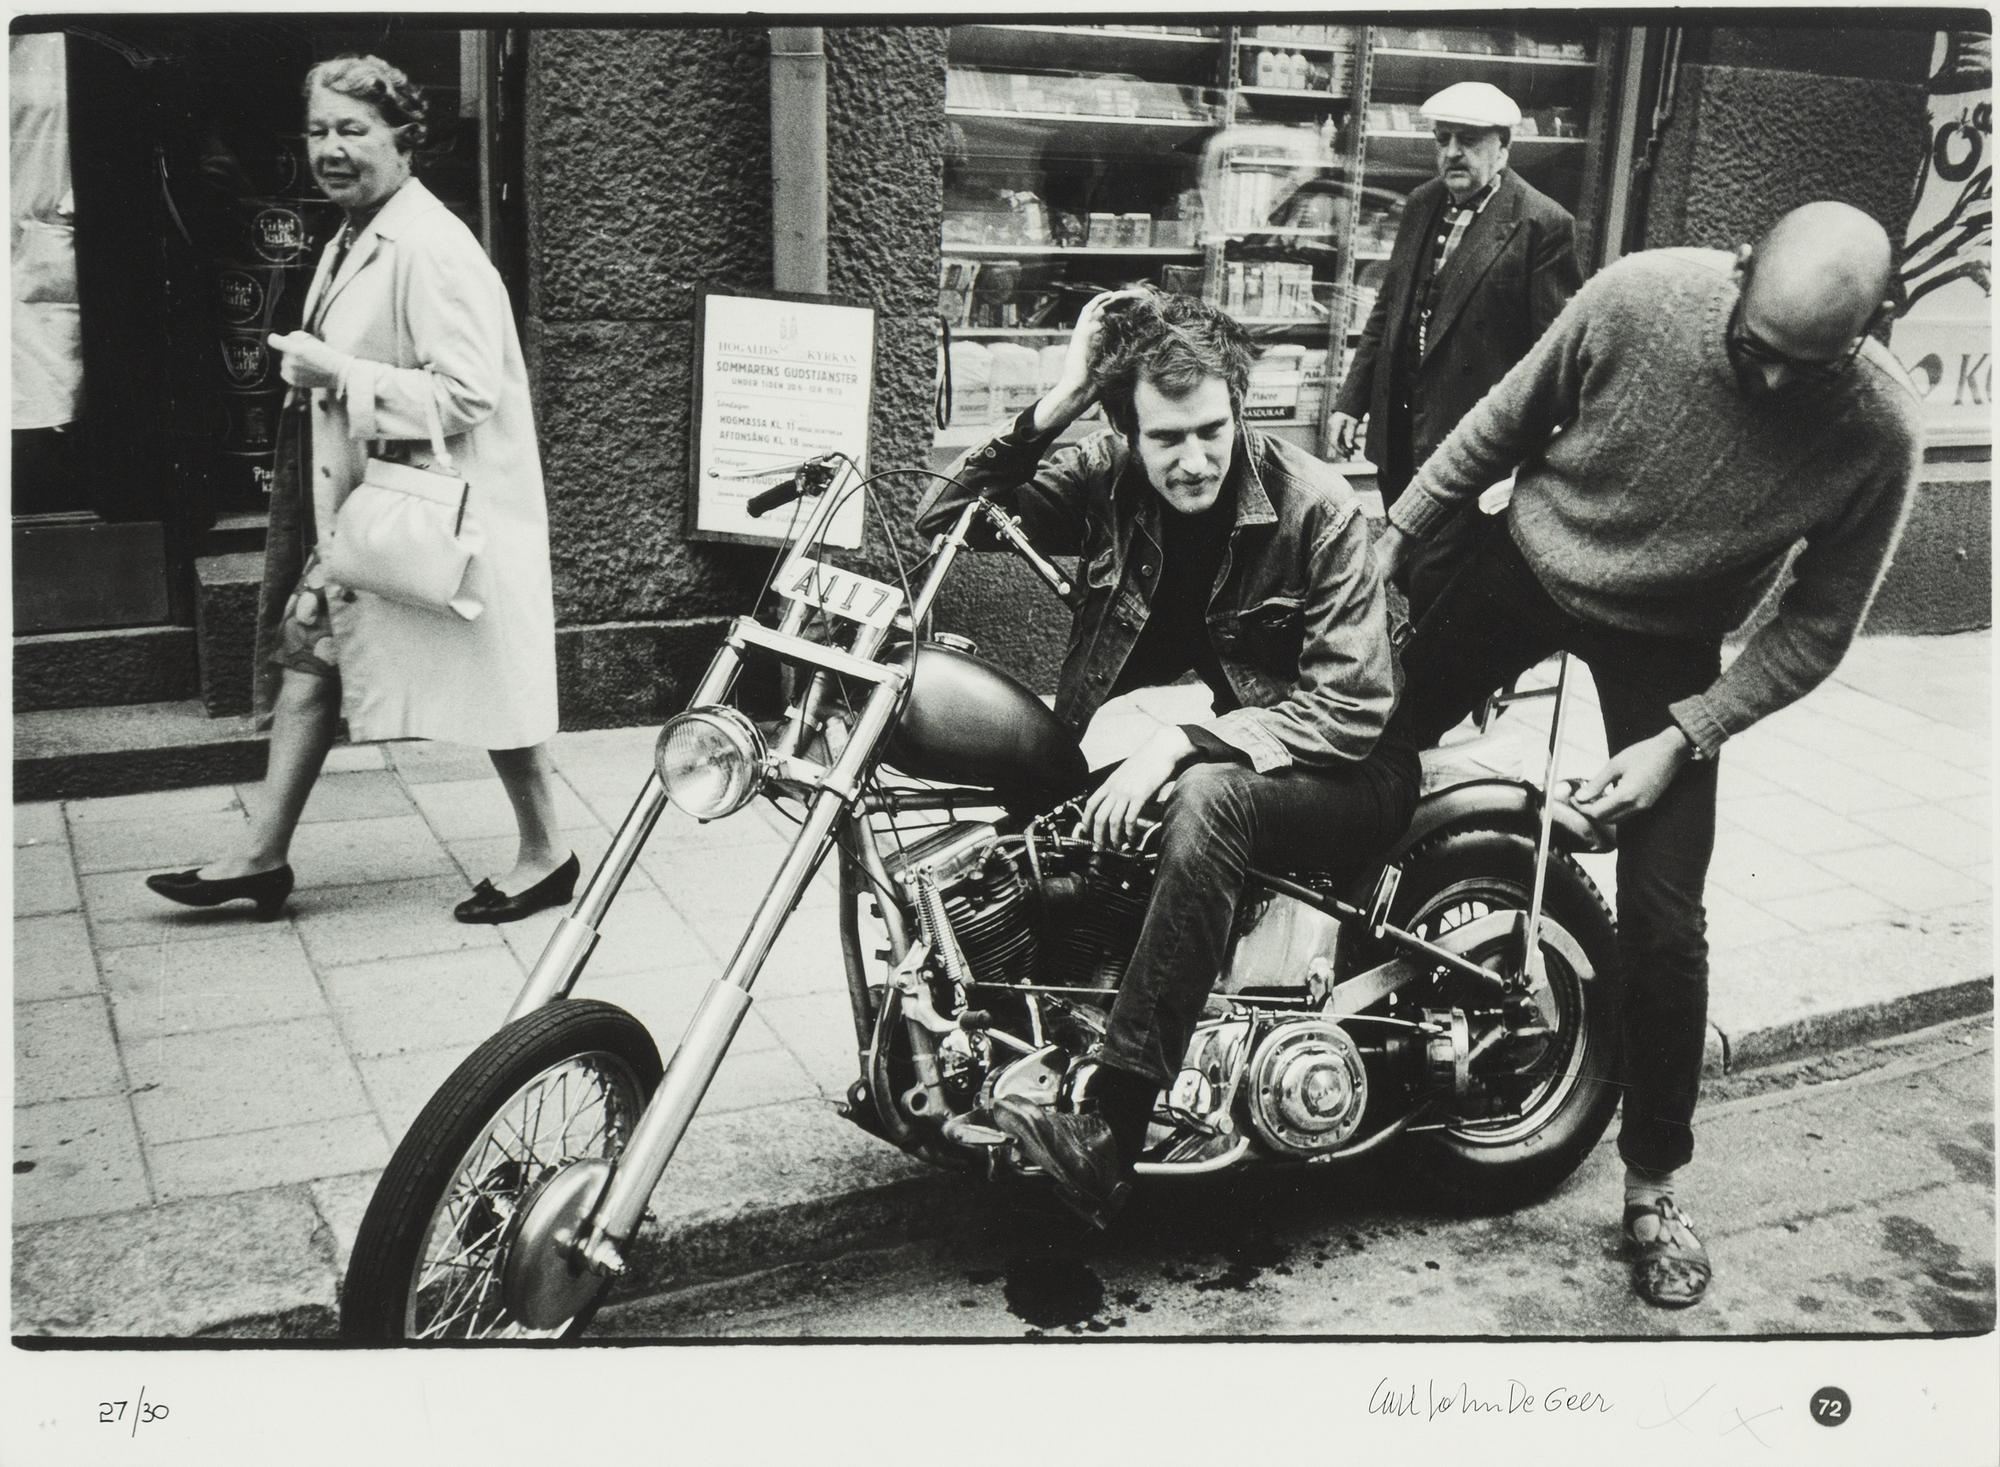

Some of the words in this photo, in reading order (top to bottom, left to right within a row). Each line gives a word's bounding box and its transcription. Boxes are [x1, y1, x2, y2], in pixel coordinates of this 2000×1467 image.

[716, 360, 780, 377] SOMMARENS
[1507, 1378, 1535, 1414] De
[1544, 1387, 1615, 1413] Geer
[1818, 1398, 1842, 1417] 72
[99, 1385, 169, 1438] 27/30
